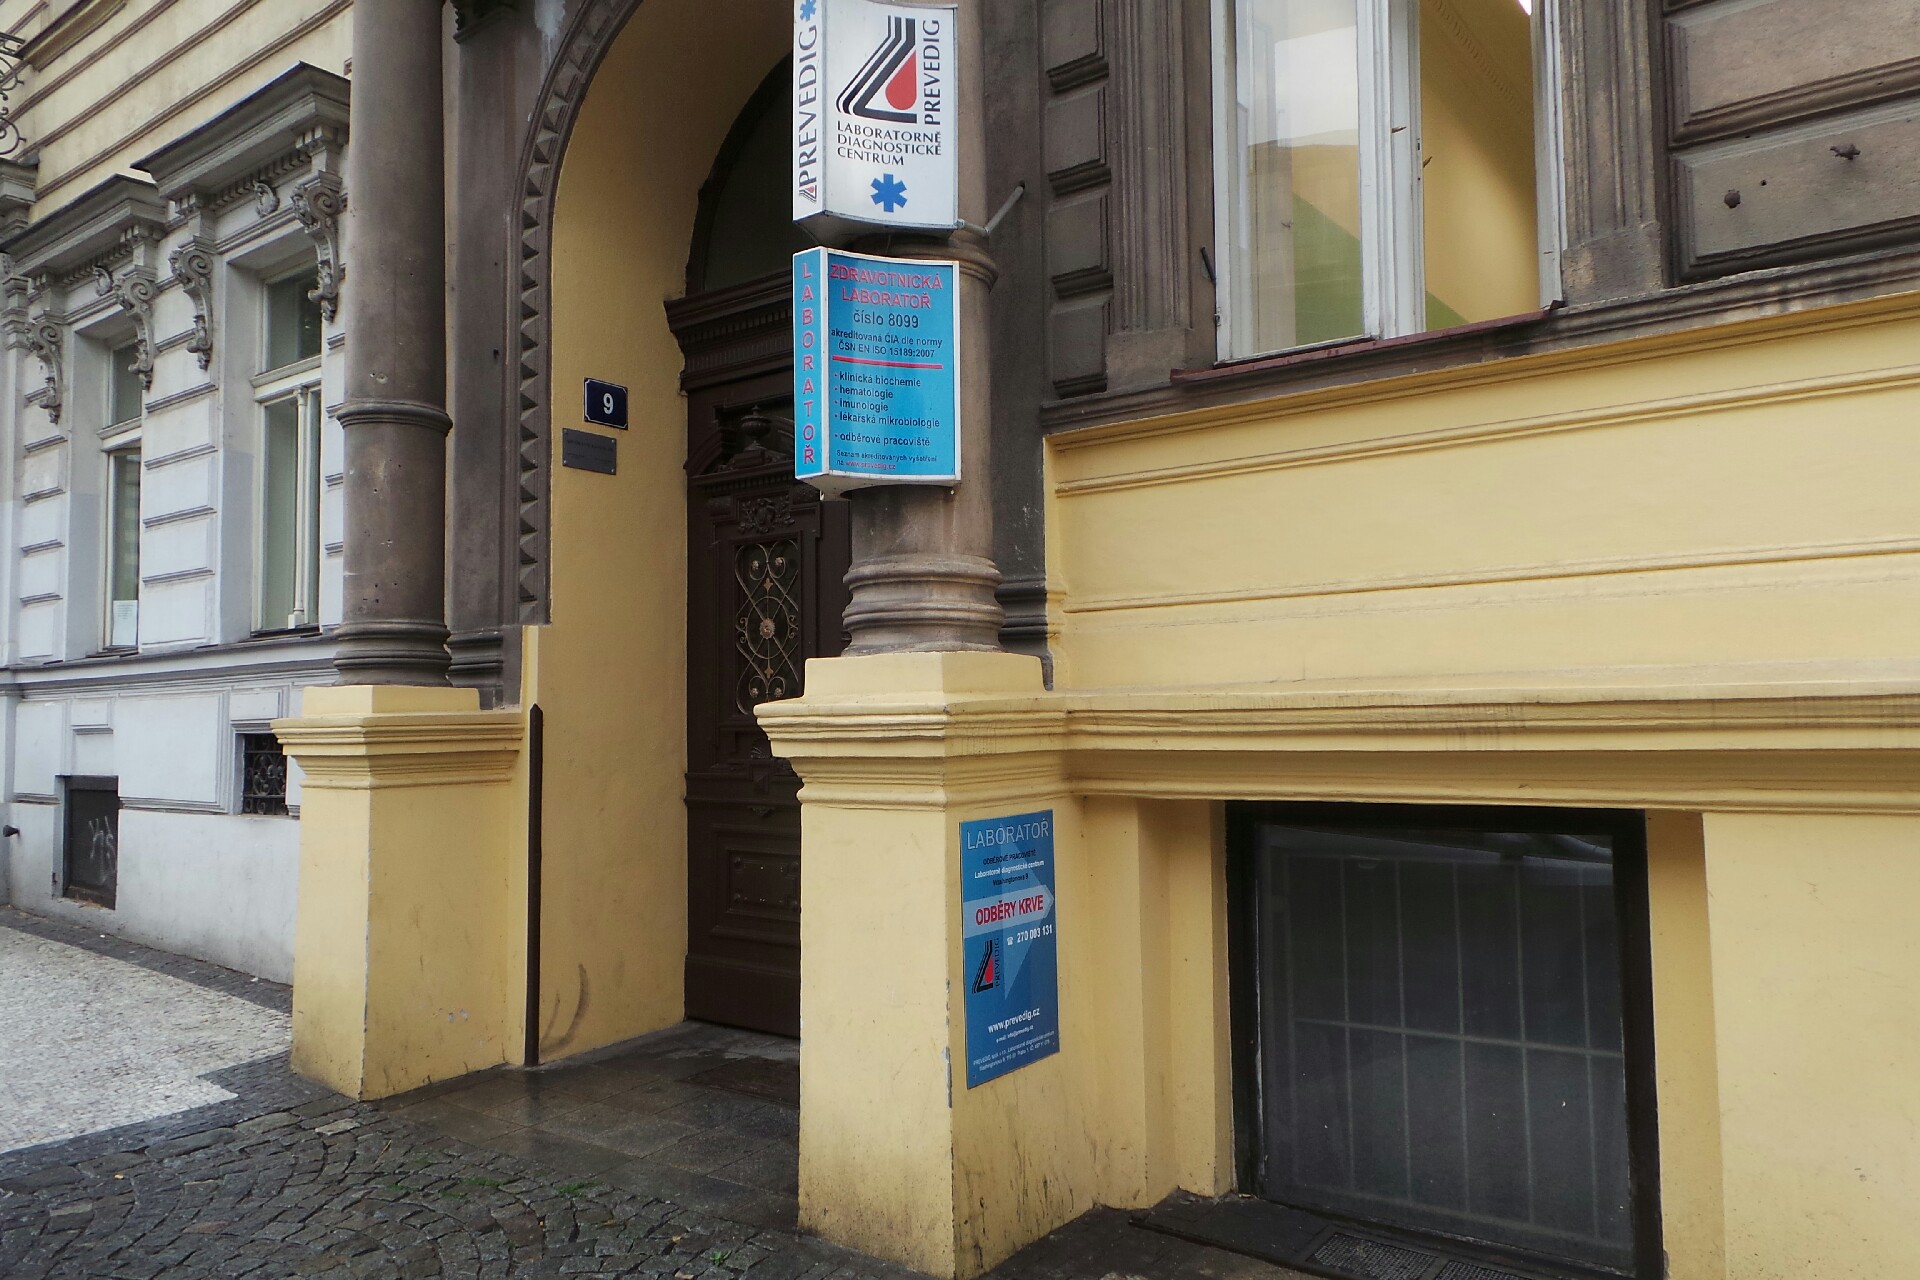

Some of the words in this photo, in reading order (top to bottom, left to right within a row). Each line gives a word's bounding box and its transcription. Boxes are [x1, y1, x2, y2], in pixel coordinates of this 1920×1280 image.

[922, 19, 941, 126] PREVEDIG
[798, 24, 818, 185] PREVEDIG
[837, 146, 904, 166] CENTRUM
[830, 263, 943, 290] ZDRAVOTNICKÁ
[841, 286, 932, 310] LABORATOŘ
[853, 309, 884, 326] číslo
[888, 313, 919, 329] 8099
[831, 328, 882, 342] akreditovaná
[901, 335, 914, 345] dle
[916, 337, 943, 348] normy
[838, 339, 856, 351] ČSN
[858, 343, 870, 353] EN
[872, 345, 887, 355] ISO
[889, 347, 935, 357] 15189:2007
[839, 371, 873, 384] klinická
[875, 375, 921, 387] biochemie
[839, 384, 894, 400] hematologie
[602, 392, 614, 415] 9
[839, 397, 889, 413] imunologie
[839, 411, 876, 424] lékařská
[878, 416, 940, 429] mikrobiologie
[839, 432, 881, 445] odběrové
[883, 436, 931, 447] pracoviště
[967, 817, 1049, 850] LABORATOŘ
[975, 900, 1017, 926] ODBĚRY
[1018, 894, 1044, 915] KRVE
[1017, 930, 1029, 944] 270
[1042, 924, 1053, 936] 131
[988, 1008, 1041, 1033] www.prevedig.cz
